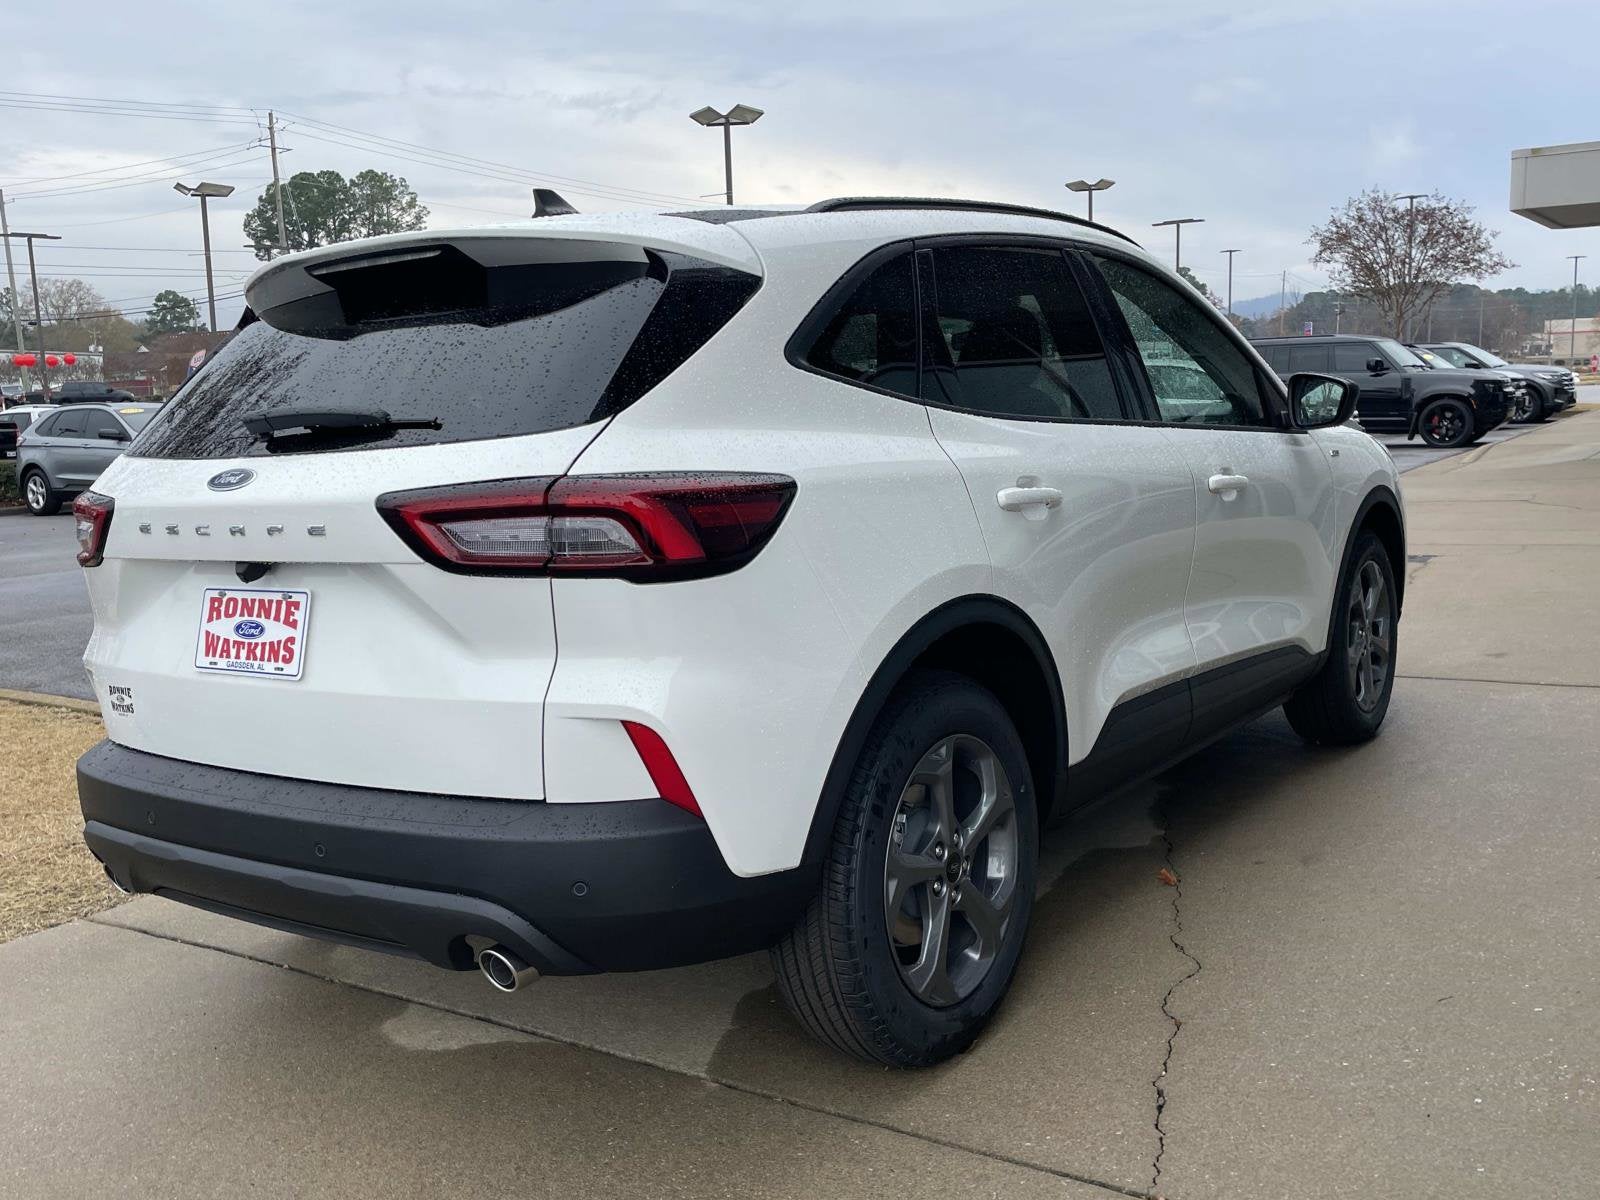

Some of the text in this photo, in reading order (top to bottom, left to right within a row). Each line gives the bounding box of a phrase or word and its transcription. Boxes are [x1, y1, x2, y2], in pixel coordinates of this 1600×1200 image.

[138, 521, 327, 536] ESCAPE
[206, 596, 301, 630] RONNIE
[237, 622, 263, 637] Ford
[204, 630, 296, 665] WATKINS
[256, 662, 265, 671] AL
[108, 685, 132, 699] RONNIE
[110, 699, 135, 714] WATKINS
